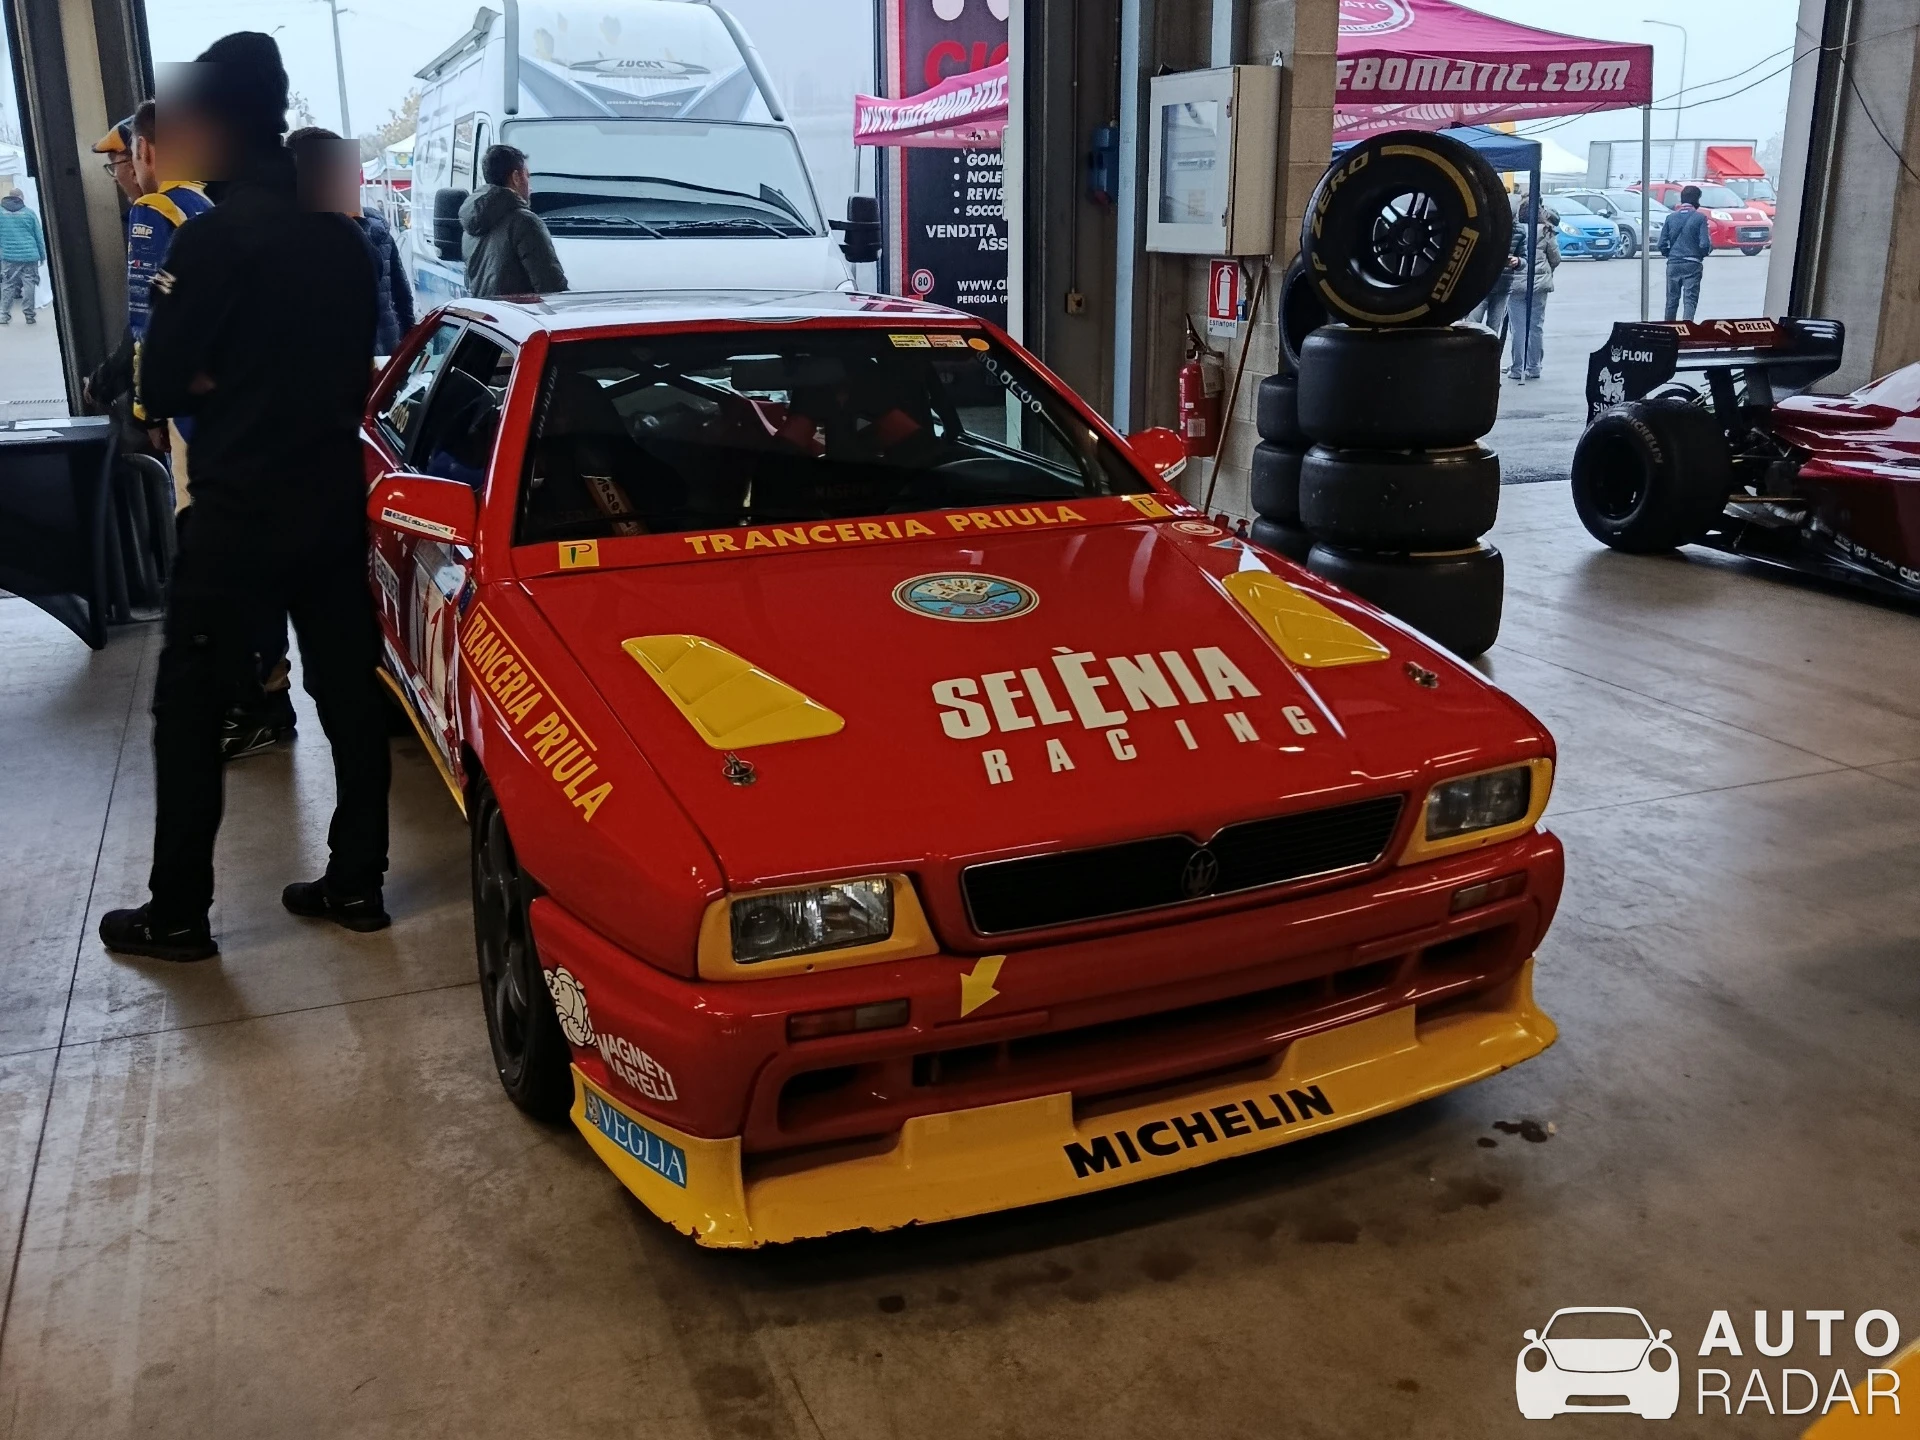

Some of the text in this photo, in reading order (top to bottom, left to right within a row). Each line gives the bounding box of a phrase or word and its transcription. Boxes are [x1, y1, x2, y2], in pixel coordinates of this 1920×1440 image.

[966, 153, 1003, 167] GOM
[1311, 151, 1370, 239] ZERO
[132, 226, 153, 236] OMP
[925, 223, 997, 238] VENDITA
[978, 237, 1008, 251] ASS
[1430, 226, 1480, 302] PIRELLI
[917, 276, 929, 287] 80
[956, 295, 998, 304] PERGOLA
[1209, 320, 1236, 329] ESTINTORE
[1737, 323, 1770, 332] ORLEN
[1621, 350, 1653, 363] FLOKI
[684, 505, 1087, 554] TRANCERIA PRIULA
[931, 646, 1262, 740] SELÈNIA
[463, 612, 613, 823] TRANCERIA PRIULA
[982, 705, 1317, 785] RACING
[597, 1033, 674, 1085] MAGNETI
[598, 1097, 686, 1184] VEGLIA
[1062, 1084, 1335, 1179] MICHELIN
